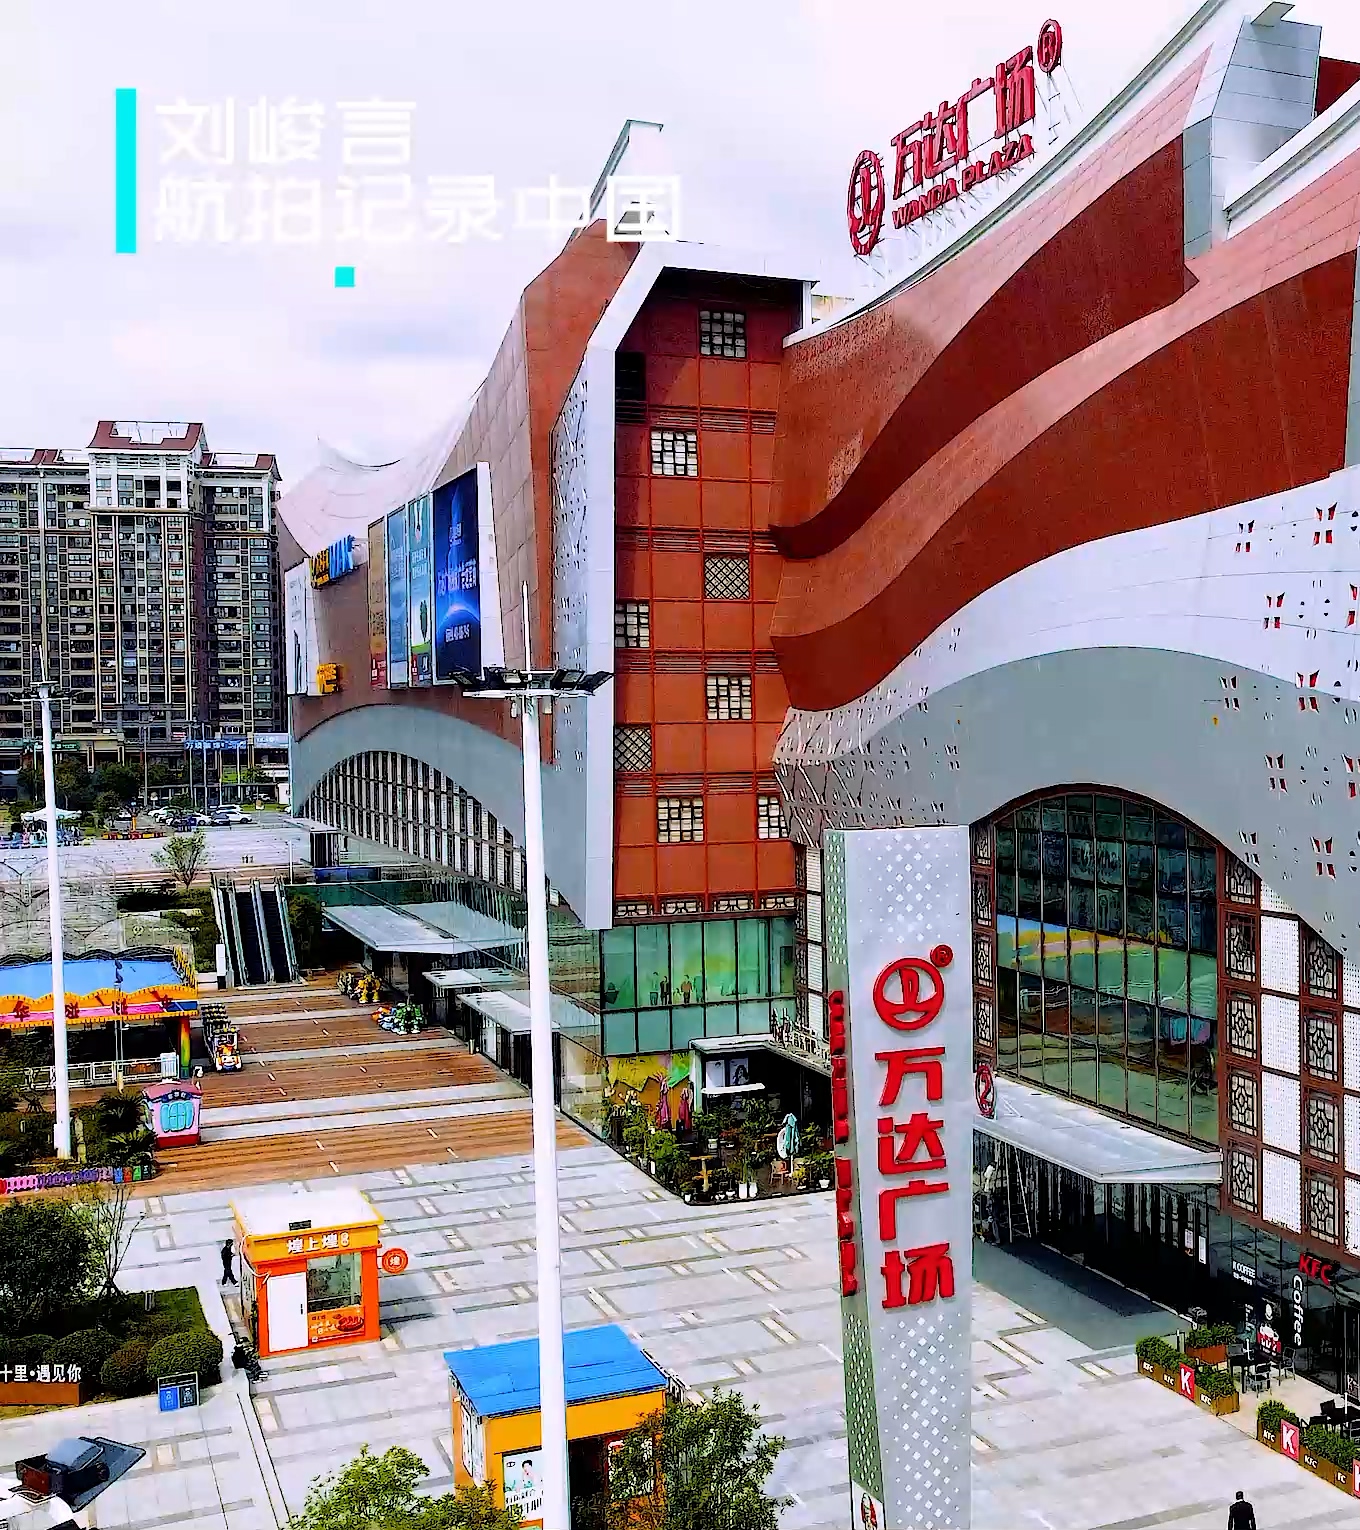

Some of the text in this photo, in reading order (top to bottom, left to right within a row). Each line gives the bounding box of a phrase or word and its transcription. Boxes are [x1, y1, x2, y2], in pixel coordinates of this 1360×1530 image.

[891, 46, 1035, 200] 万达广场
[892, 134, 1035, 230] WANDA PLAZA
[874, 1046, 956, 1308] 万达广场
[286, 1232, 339, 1255] 煌上煌
[1237, 1262, 1256, 1279] COFFEE
[1299, 1252, 1333, 1287] KFC
[1293, 1274, 1304, 1347] Coffee
[1143, 1361, 1154, 1373] KFC
[1180, 1367, 1191, 1395] K
[1201, 1394, 1212, 1405] KFC
[1263, 1430, 1275, 1442] KFC
[1281, 1428, 1296, 1455] K
[1304, 1455, 1318, 1469] KFC
